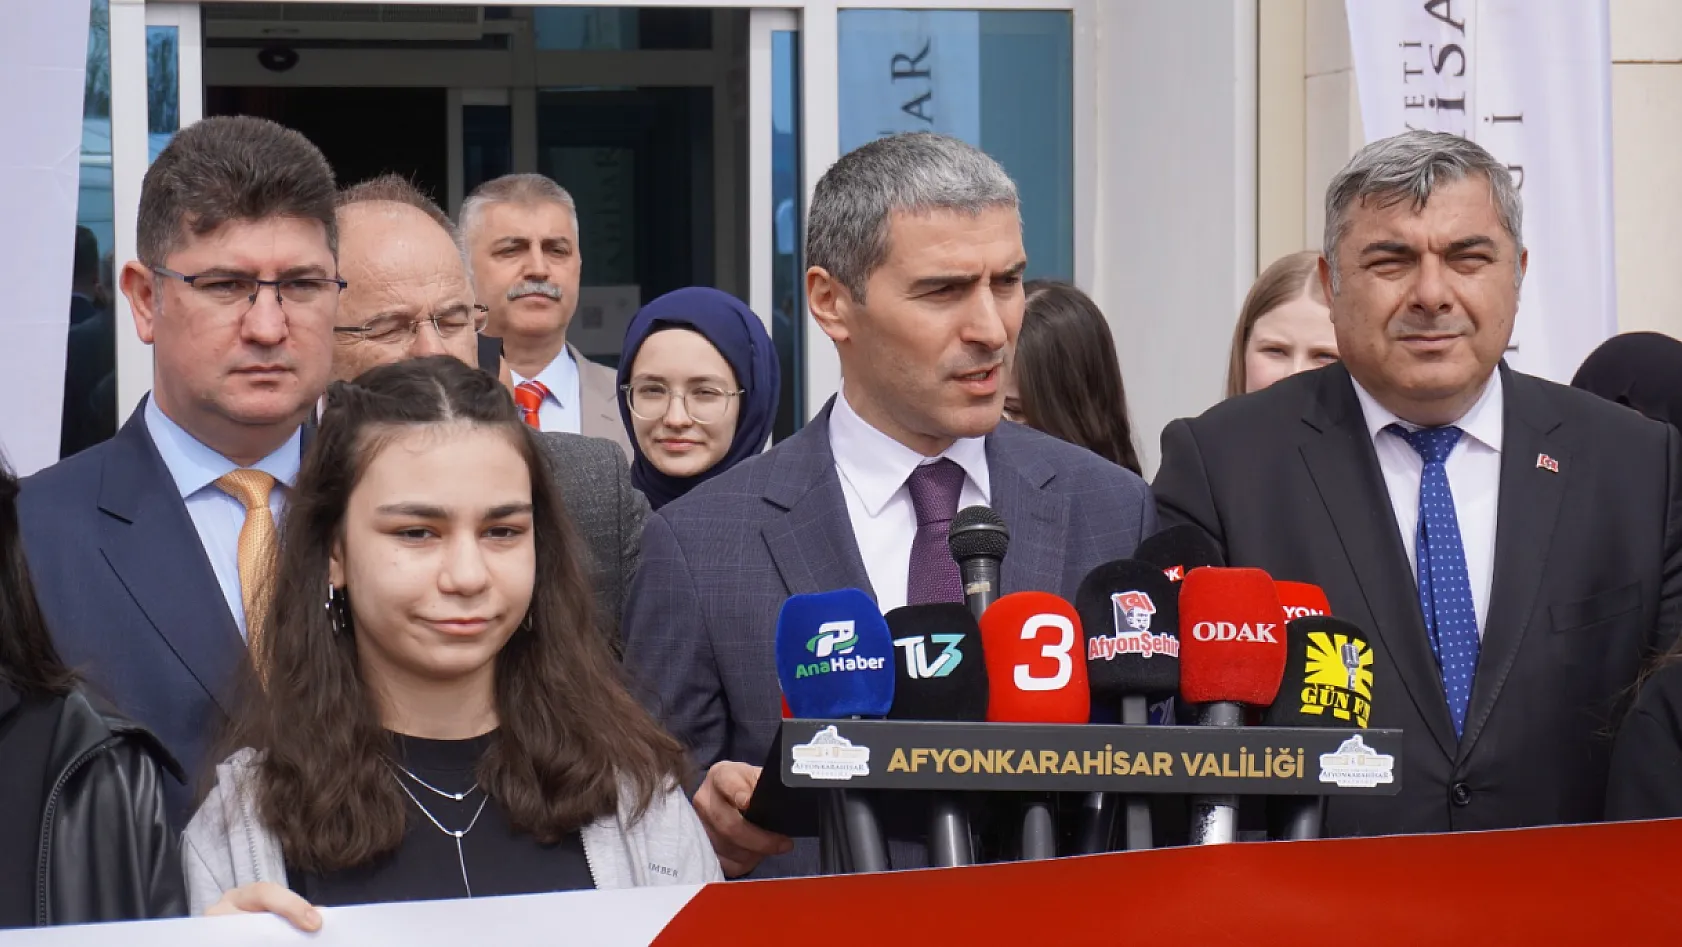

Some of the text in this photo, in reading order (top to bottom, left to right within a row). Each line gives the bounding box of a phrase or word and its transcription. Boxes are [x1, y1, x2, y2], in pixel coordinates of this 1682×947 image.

[890, 36, 934, 134] AR
[1399, 41, 1424, 131] ETİ
[1013, 613, 1074, 691] 3
[1192, 621, 1278, 644] ODAK
[795, 655, 886, 679] AnaHaber
[893, 633, 966, 679] TV3
[1301, 685, 1350, 709] GÜN
[887, 744, 1305, 779] AFYONKARAHİSAR VALİLİĞİ
